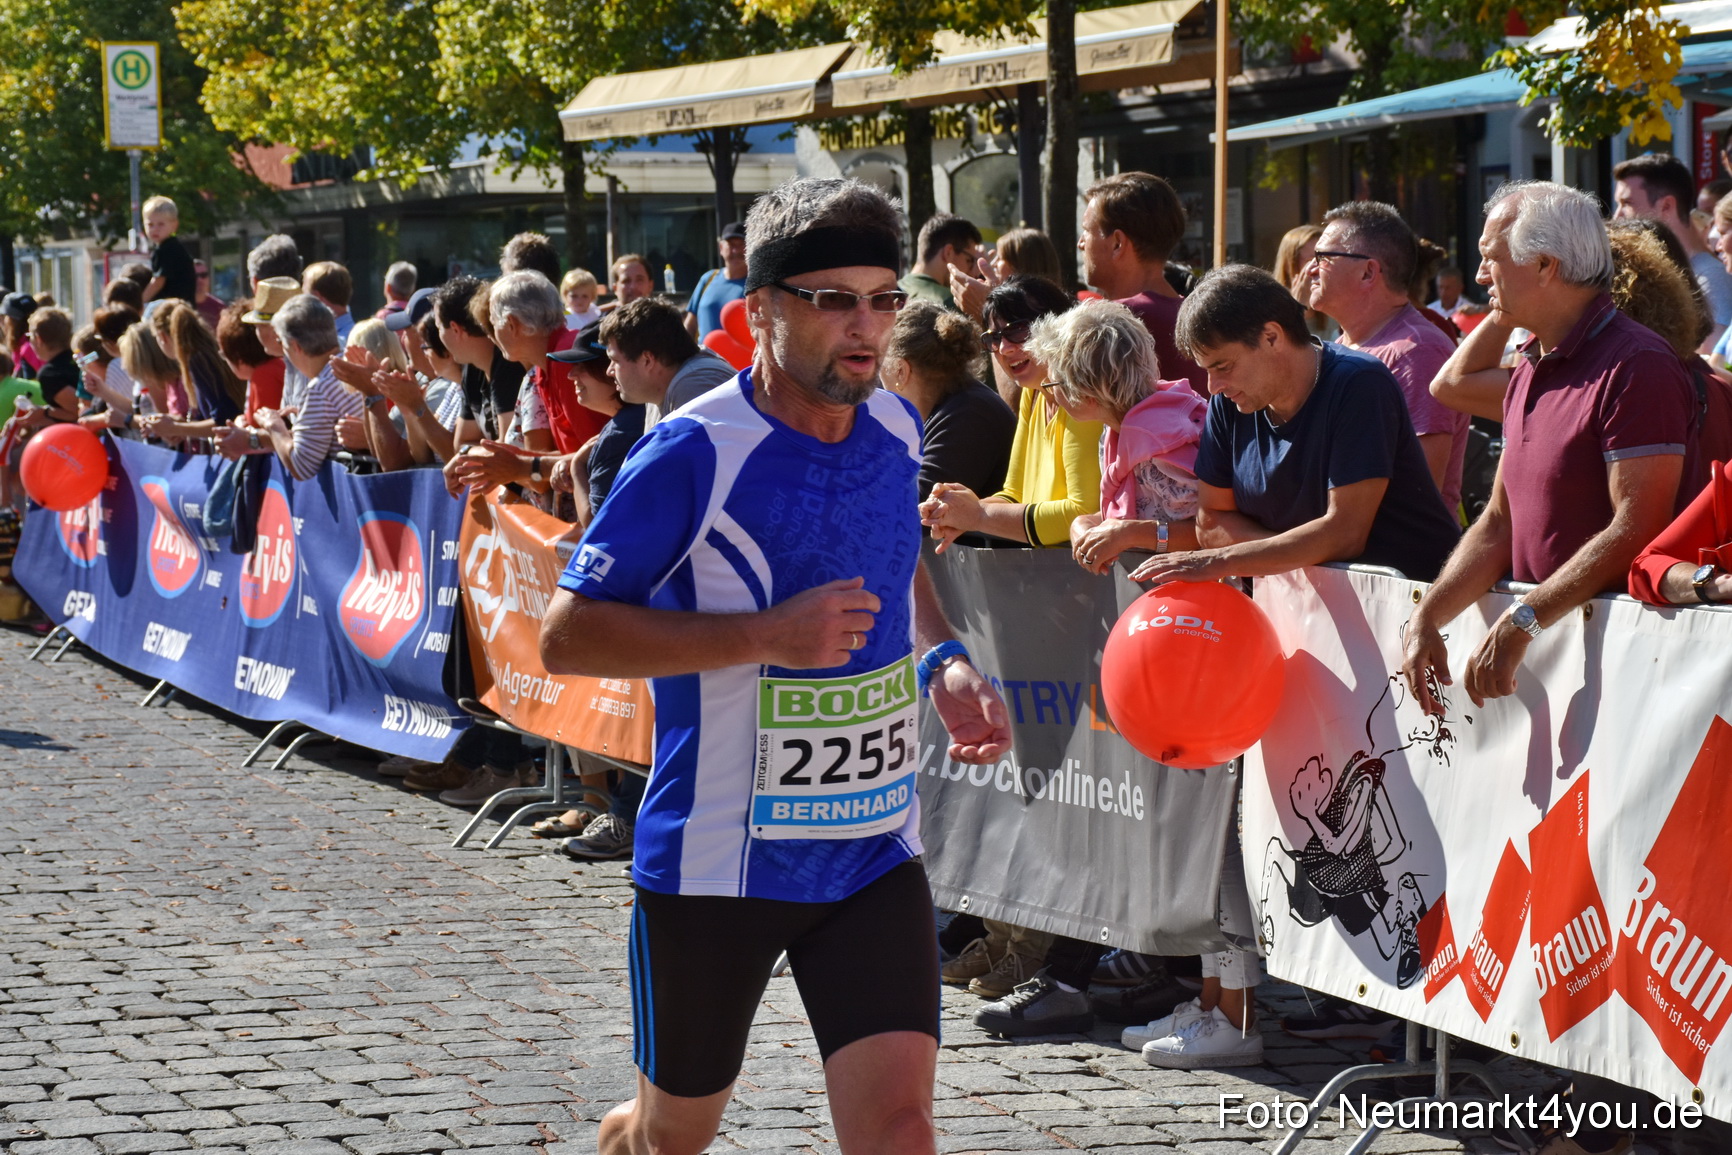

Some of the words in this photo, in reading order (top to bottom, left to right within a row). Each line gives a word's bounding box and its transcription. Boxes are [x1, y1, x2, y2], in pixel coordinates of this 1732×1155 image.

[122, 60, 141, 81] H
[1700, 130, 1713, 179] Store
[345, 548, 421, 633] hervis
[1173, 627, 1221, 643] energie
[381, 693, 409, 732] GET
[776, 668, 909, 720] BOCK
[779, 718, 906, 786] 2255
[771, 784, 909, 821] BERNHARD
[1468, 915, 1504, 993] Braun
[1530, 904, 1607, 999] Braun
[1621, 863, 1732, 1022] Braun
[1565, 972, 1590, 997] Sicher
[1590, 964, 1601, 980] ist
[1599, 950, 1617, 972] sicher
[1646, 974, 1670, 1013] Sicher
[1668, 1003, 1683, 1028] ist
[1680, 1020, 1713, 1056] sicher
